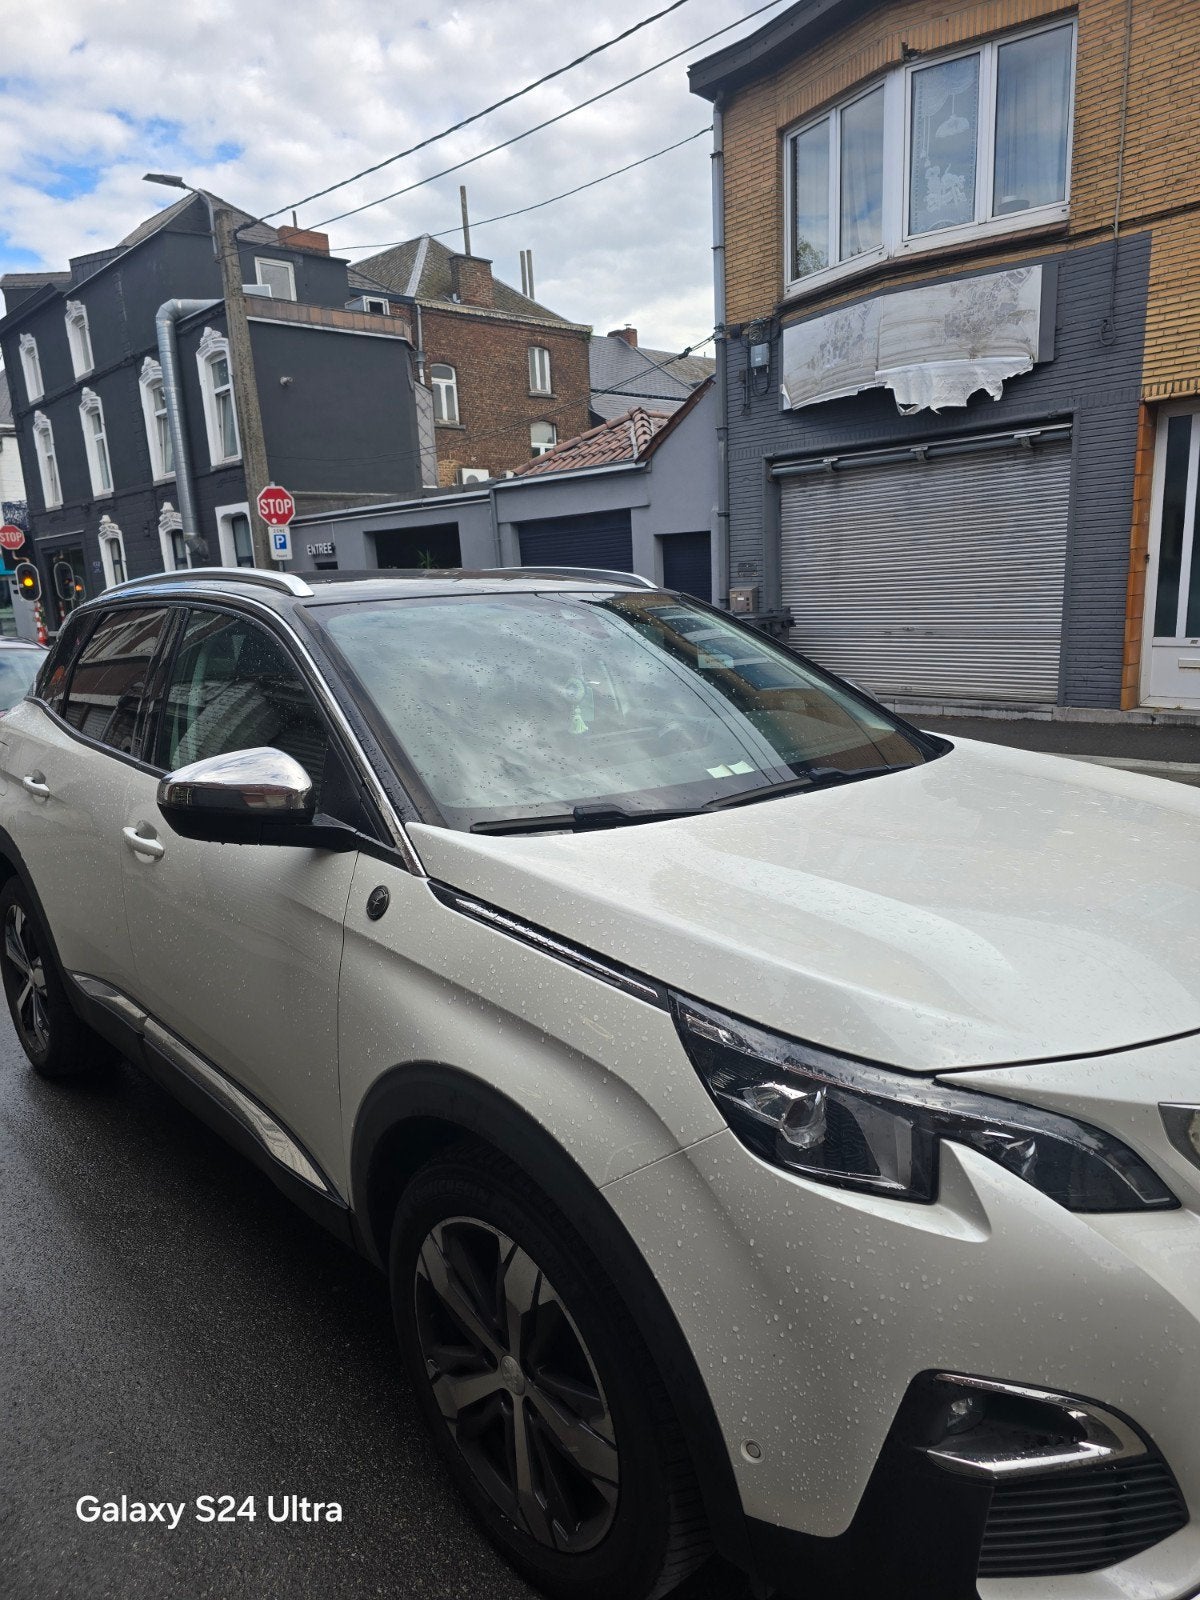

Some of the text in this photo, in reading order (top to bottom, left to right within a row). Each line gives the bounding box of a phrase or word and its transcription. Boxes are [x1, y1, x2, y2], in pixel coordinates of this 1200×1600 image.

[260, 499, 292, 514] STOP
[0, 532, 22, 542] STOP
[275, 535, 285, 549] P
[306, 543, 333, 555] ENTREE
